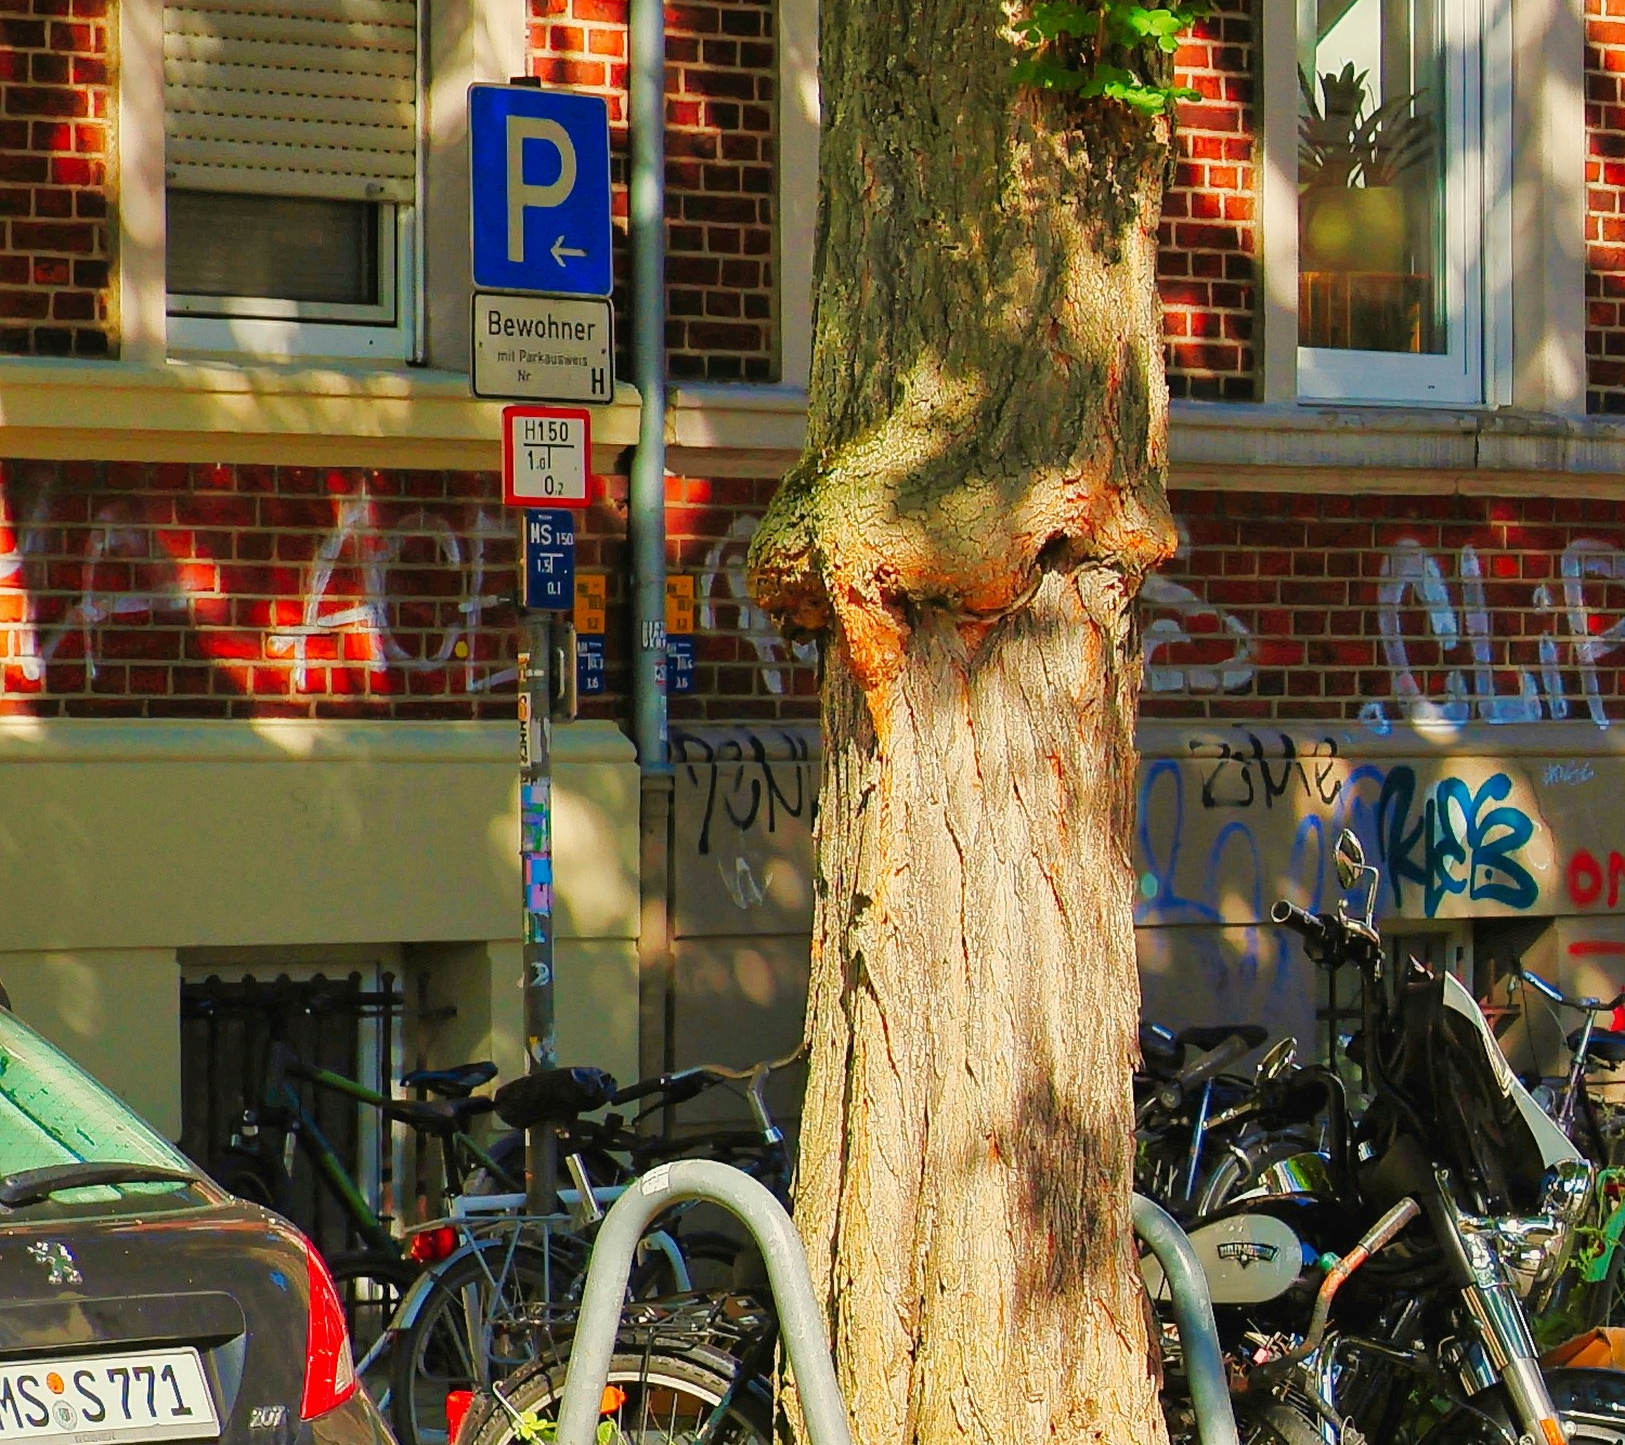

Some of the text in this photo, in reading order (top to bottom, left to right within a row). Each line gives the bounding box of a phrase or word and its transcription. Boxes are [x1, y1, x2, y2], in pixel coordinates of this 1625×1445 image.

[506, 114, 578, 264] P
[487, 310, 596, 342] Bewohner
[591, 367, 605, 395] H
